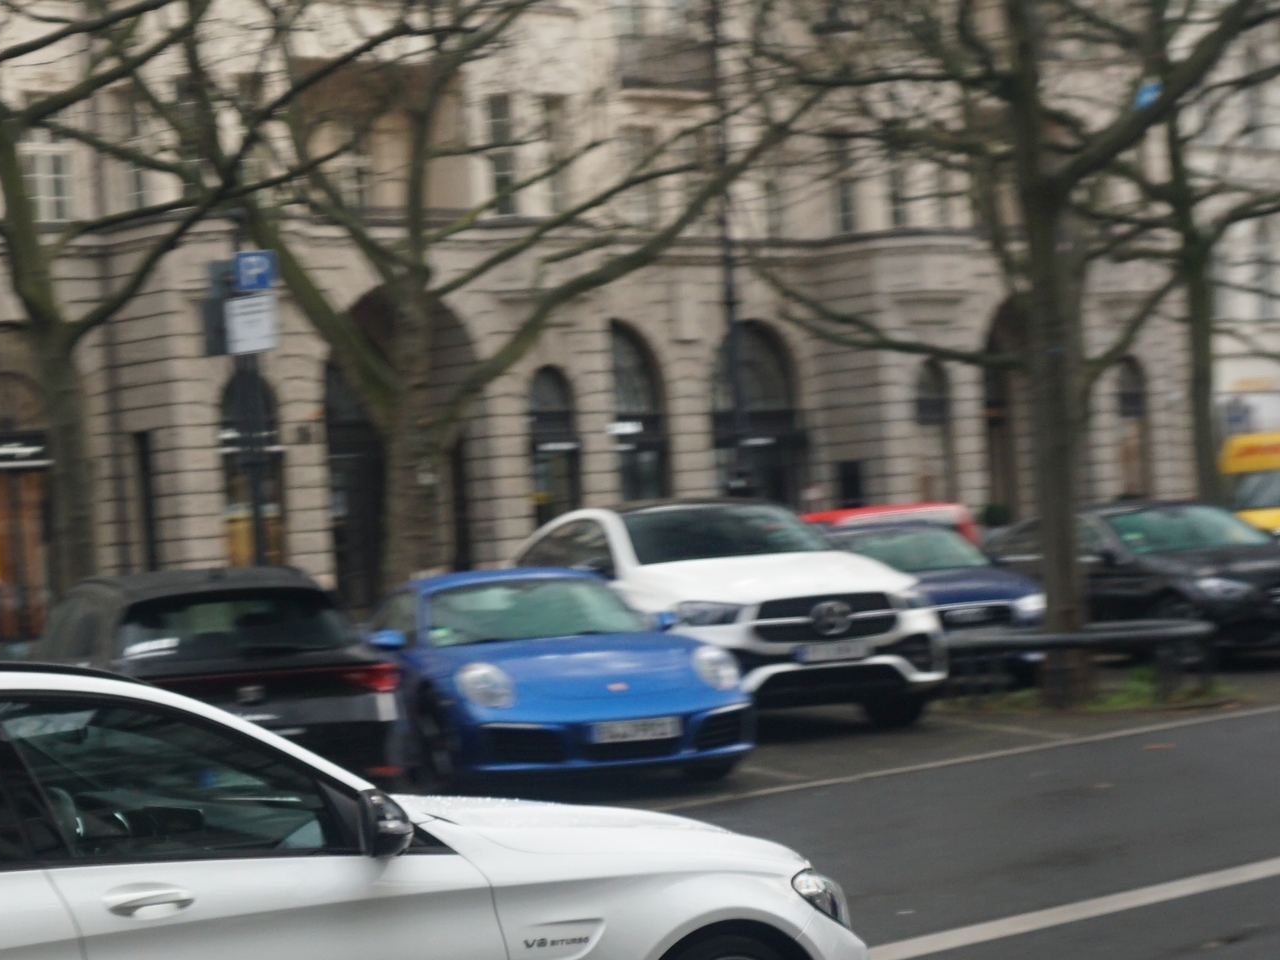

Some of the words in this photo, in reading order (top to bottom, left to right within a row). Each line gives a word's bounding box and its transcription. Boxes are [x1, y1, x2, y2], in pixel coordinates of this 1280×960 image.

[239, 255, 271, 286] P
[523, 937, 548, 949] V8
[549, 936, 590, 947] BITURBO
